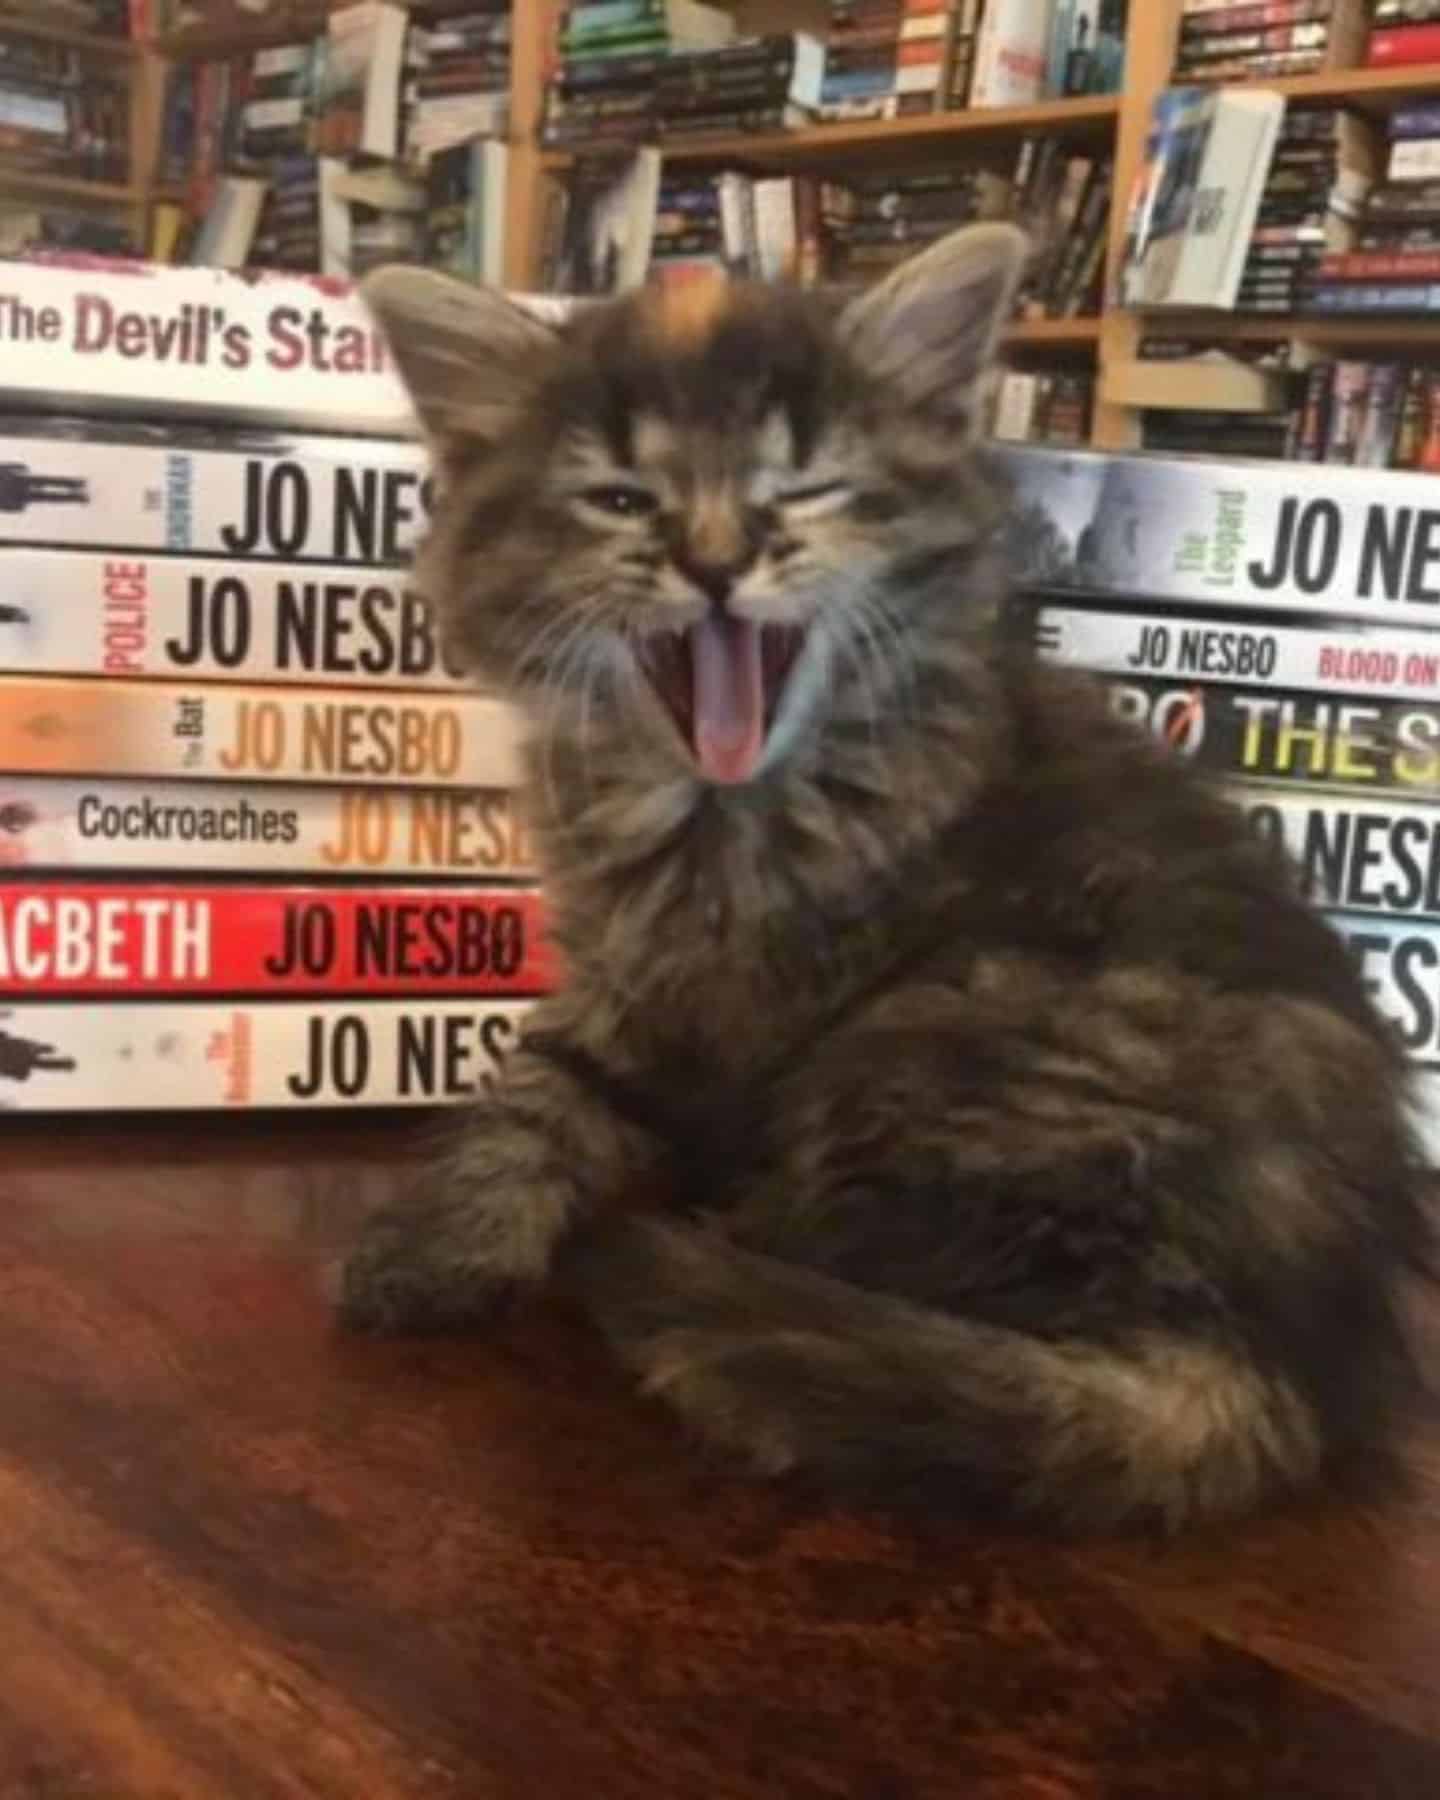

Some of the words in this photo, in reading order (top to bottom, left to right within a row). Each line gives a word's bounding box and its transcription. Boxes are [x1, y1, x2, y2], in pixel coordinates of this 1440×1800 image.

[72, 294, 251, 370] Devil's
[220, 460, 311, 556] JO
[333, 467, 434, 563] NE
[1203, 490, 1248, 587] Leopard
[1247, 495, 1341, 593] JO
[1356, 502, 1440, 604] NE
[104, 562, 147, 673] POLICE
[164, 577, 251, 668] JO
[275, 581, 466, 679] NESB
[1127, 625, 1169, 668] JO
[1177, 631, 1277, 679] NESBO
[1318, 645, 1399, 684] BLOOD
[1403, 652, 1439, 686] ON
[173, 696, 204, 738] Bat
[218, 701, 286, 771] JO
[302, 704, 463, 778] NESBO
[1233, 695, 1381, 779] THE
[77, 795, 299, 842] Cockroaches
[318, 789, 391, 866] JO
[0, 897, 211, 981] CBETH
[264, 904, 337, 977] JO
[285, 1014, 370, 1098] JO
